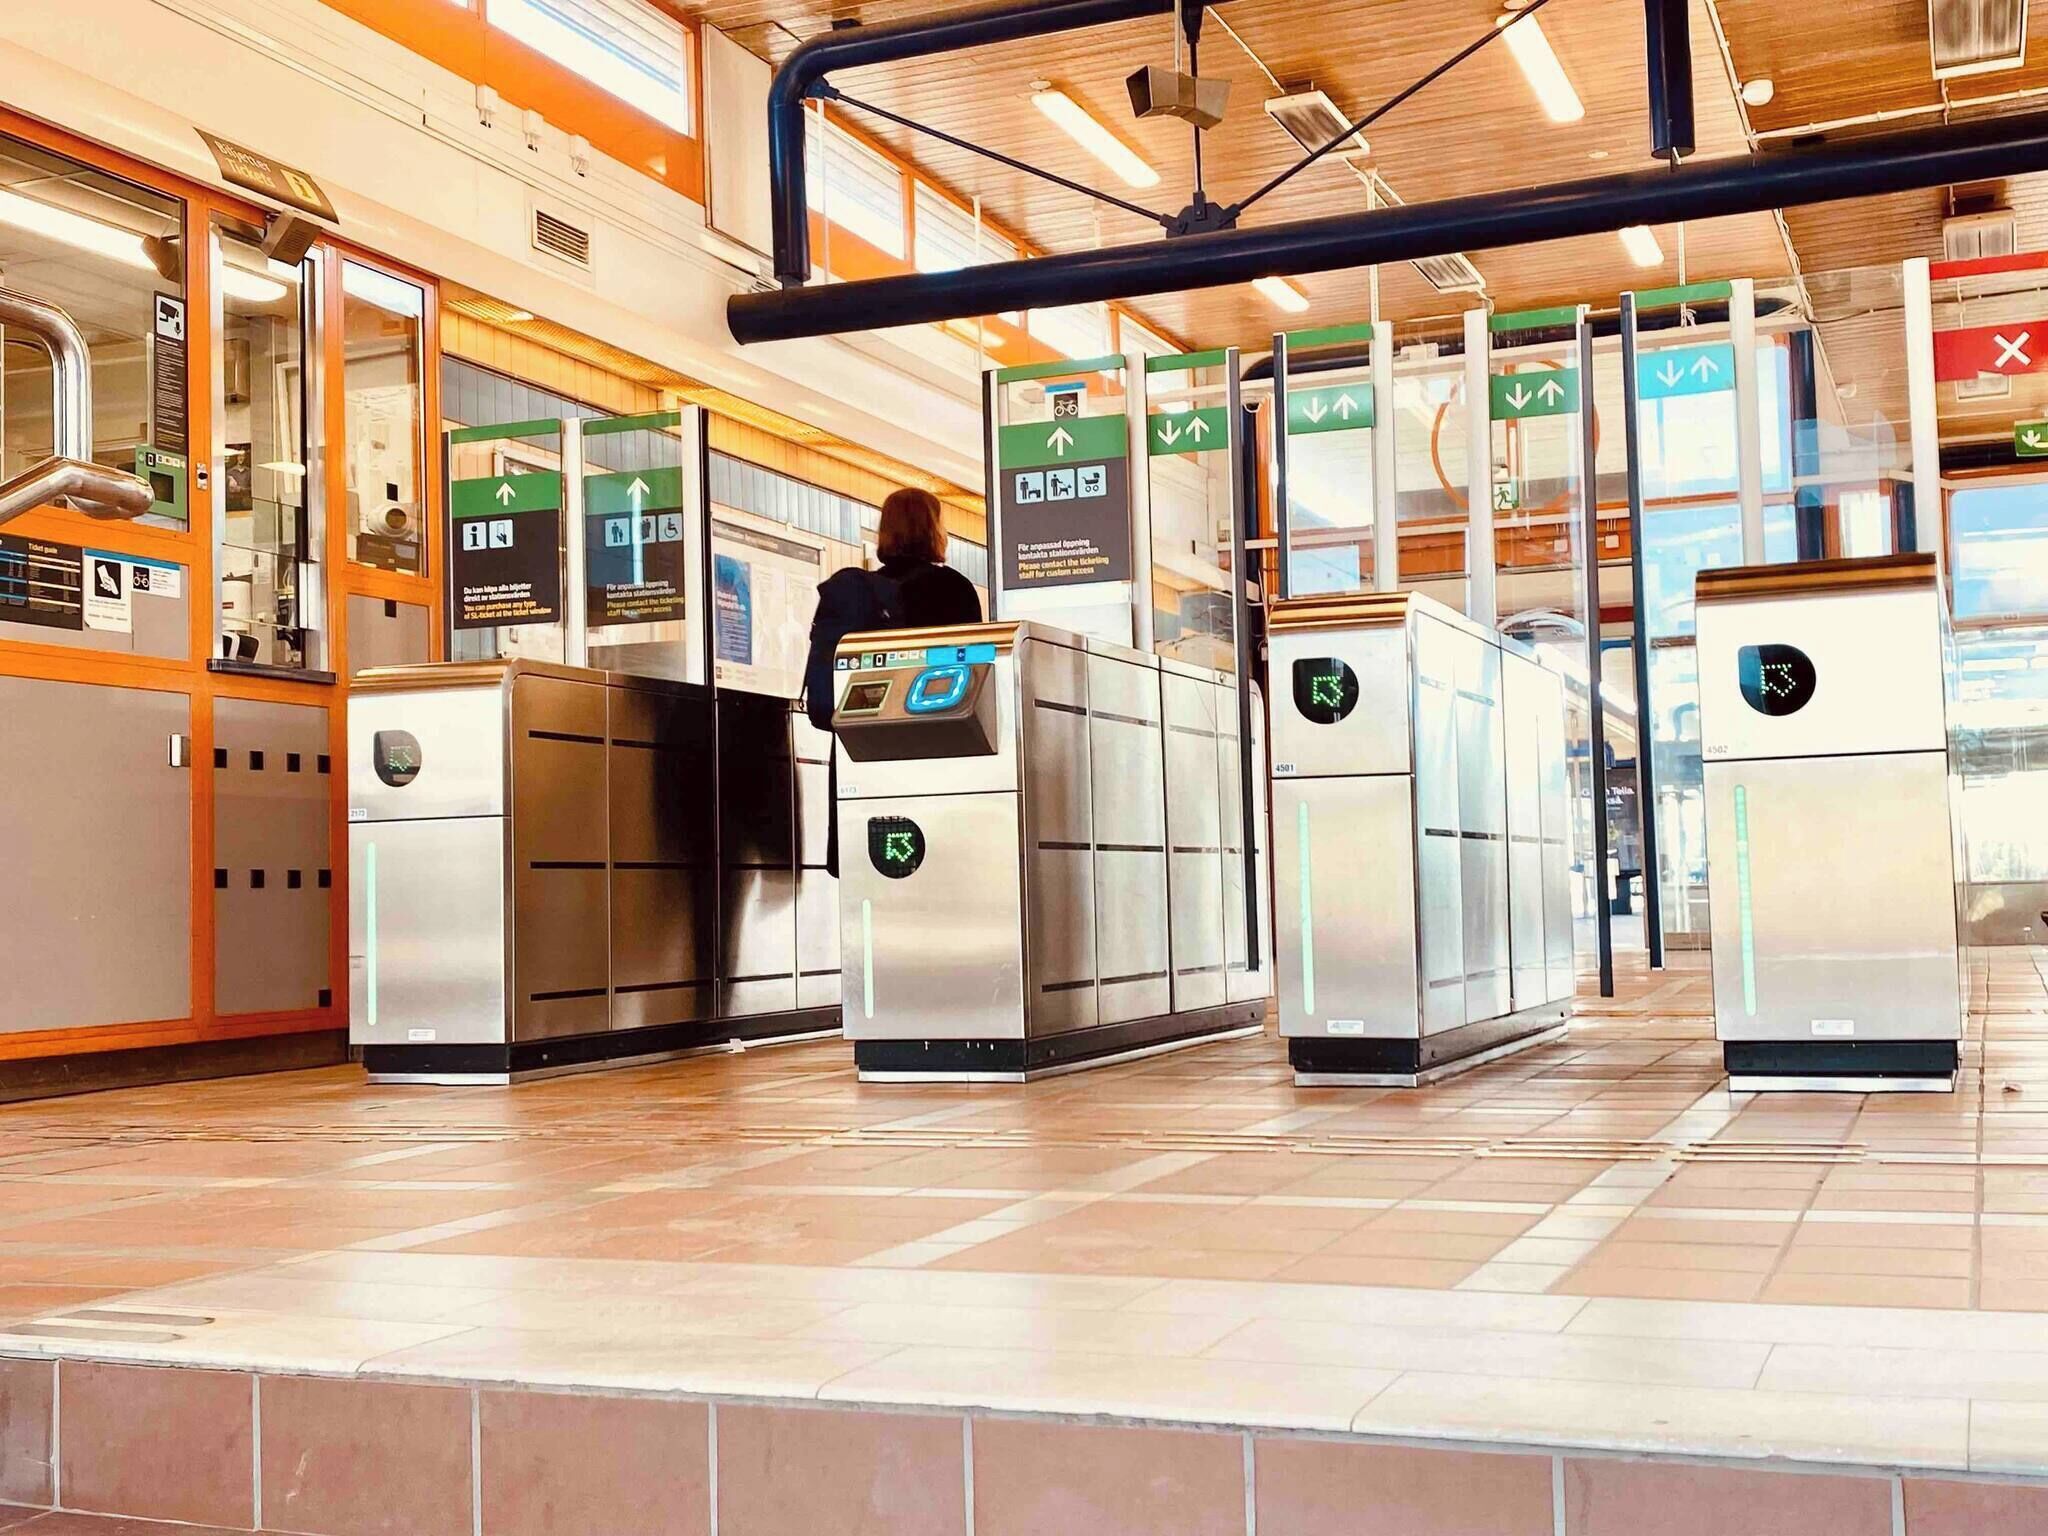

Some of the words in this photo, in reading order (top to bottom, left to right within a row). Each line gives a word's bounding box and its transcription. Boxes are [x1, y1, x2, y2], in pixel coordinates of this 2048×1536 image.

[214, 140, 271, 173] Biljetter
[224, 158, 276, 188] Tickets
[28, 543, 44, 552] Ticket
[1018, 543, 1029, 552] För
[1030, 540, 1062, 551] anpassad
[1063, 538, 1090, 549] öppning
[1018, 550, 1048, 560] kontakta
[1049, 547, 1099, 558] stationsvärden
[1018, 562, 1040, 571] Please
[1041, 559, 1067, 569] contact
[1068, 558, 1078, 567] the
[1080, 556, 1109, 566] ticketing
[1019, 570, 1034, 579] staff
[1036, 570, 1045, 578] for
[1047, 568, 1071, 577] custom
[1072, 566, 1094, 575] access
[472, 586, 483, 594] kan
[484, 584, 498, 594] köpa
[498, 584, 509, 592] alla
[509, 582, 532, 591] biljetter
[607, 583, 616, 591] För
[607, 591, 632, 599] kontakta
[633, 587, 676, 598] stationsvärden
[463, 594, 481, 603] direkt
[489, 591, 531, 601] stationsvärden
[607, 601, 626, 609] Please
[627, 599, 648, 607] contact
[659, 596, 684, 605] ticketing
[464, 604, 474, 612] You
[486, 602, 512, 612] purchase
[512, 601, 523, 609] any
[523, 600, 537, 608] type
[464, 612, 470, 620] of
[471, 611, 496, 620] SL-ticket
[503, 609, 512, 617] the
[513, 608, 529, 616] ticket
[529, 606, 552, 615] window
[607, 609, 620, 617] staff
[1275, 764, 1294, 772] 4501
